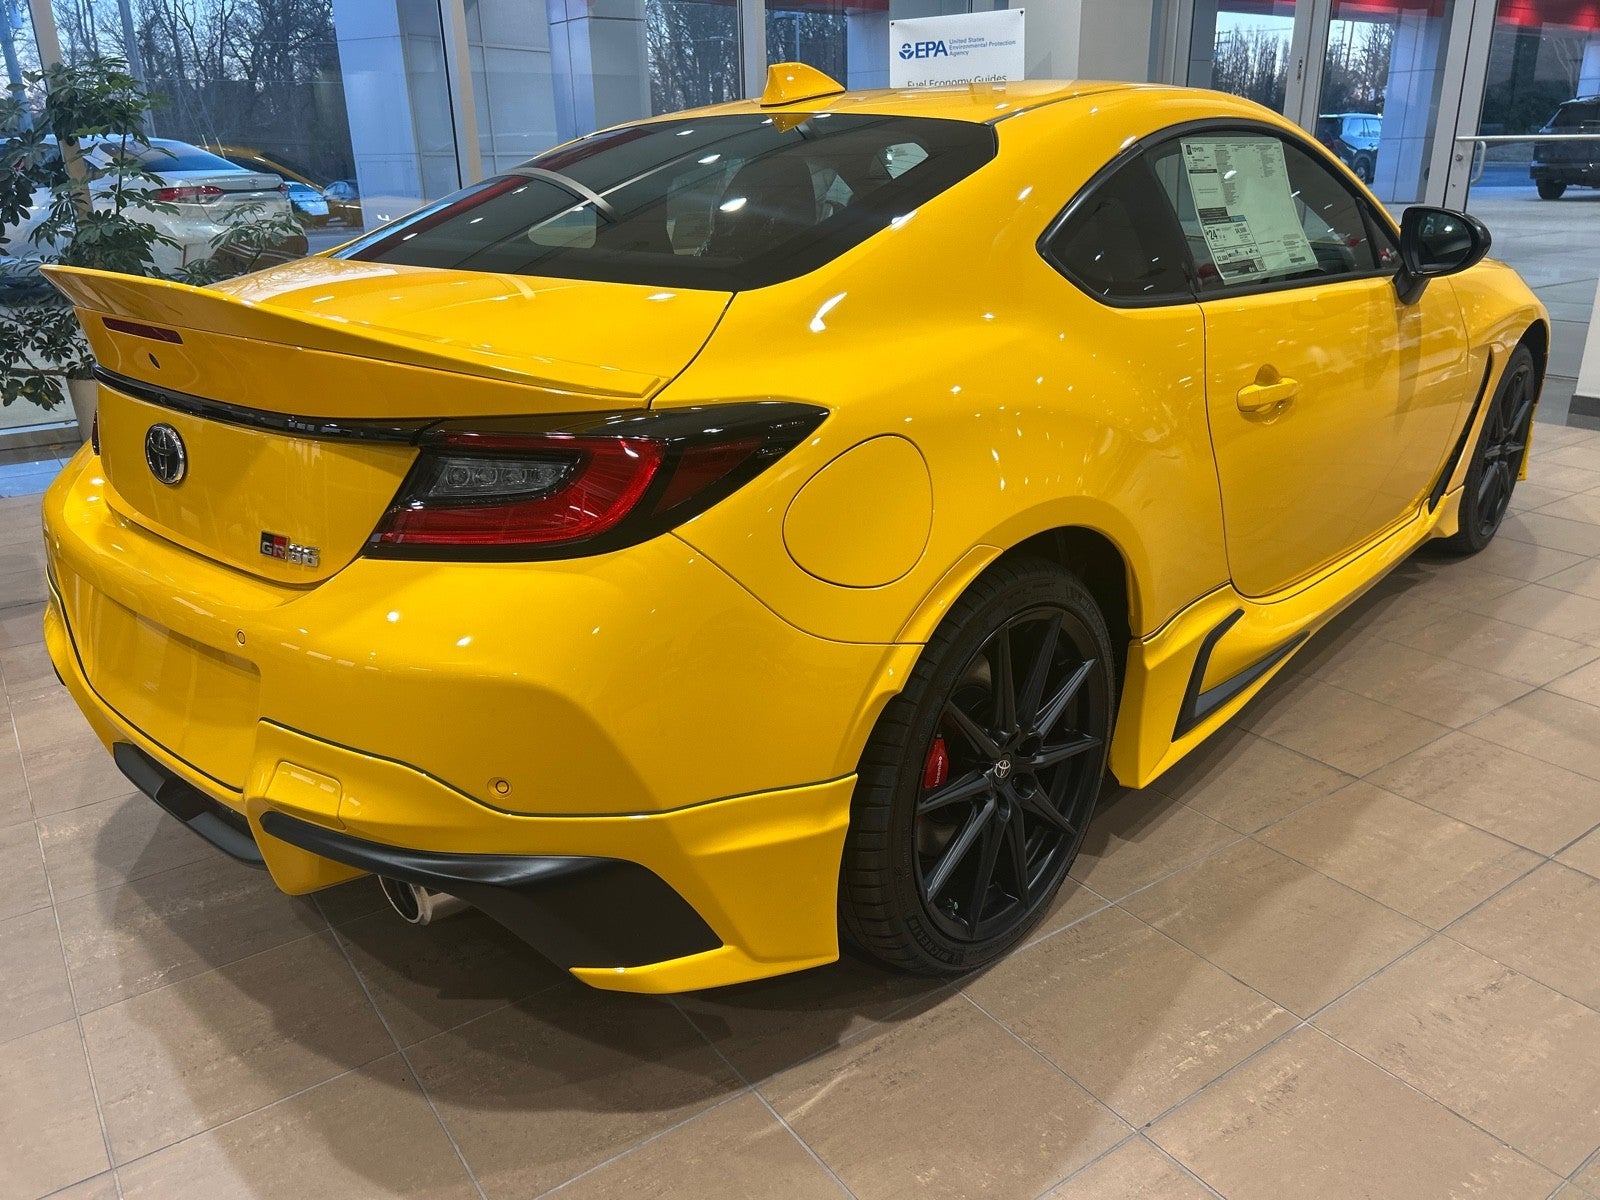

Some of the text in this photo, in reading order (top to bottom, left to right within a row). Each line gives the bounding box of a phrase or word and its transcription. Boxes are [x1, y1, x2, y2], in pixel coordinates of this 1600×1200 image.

[914, 40, 948, 58] EPA
[949, 42, 987, 50] Environmental
[949, 49, 970, 57] Agency
[974, 74, 1007, 83] Guides
[261, 541, 320, 567] GR 86
